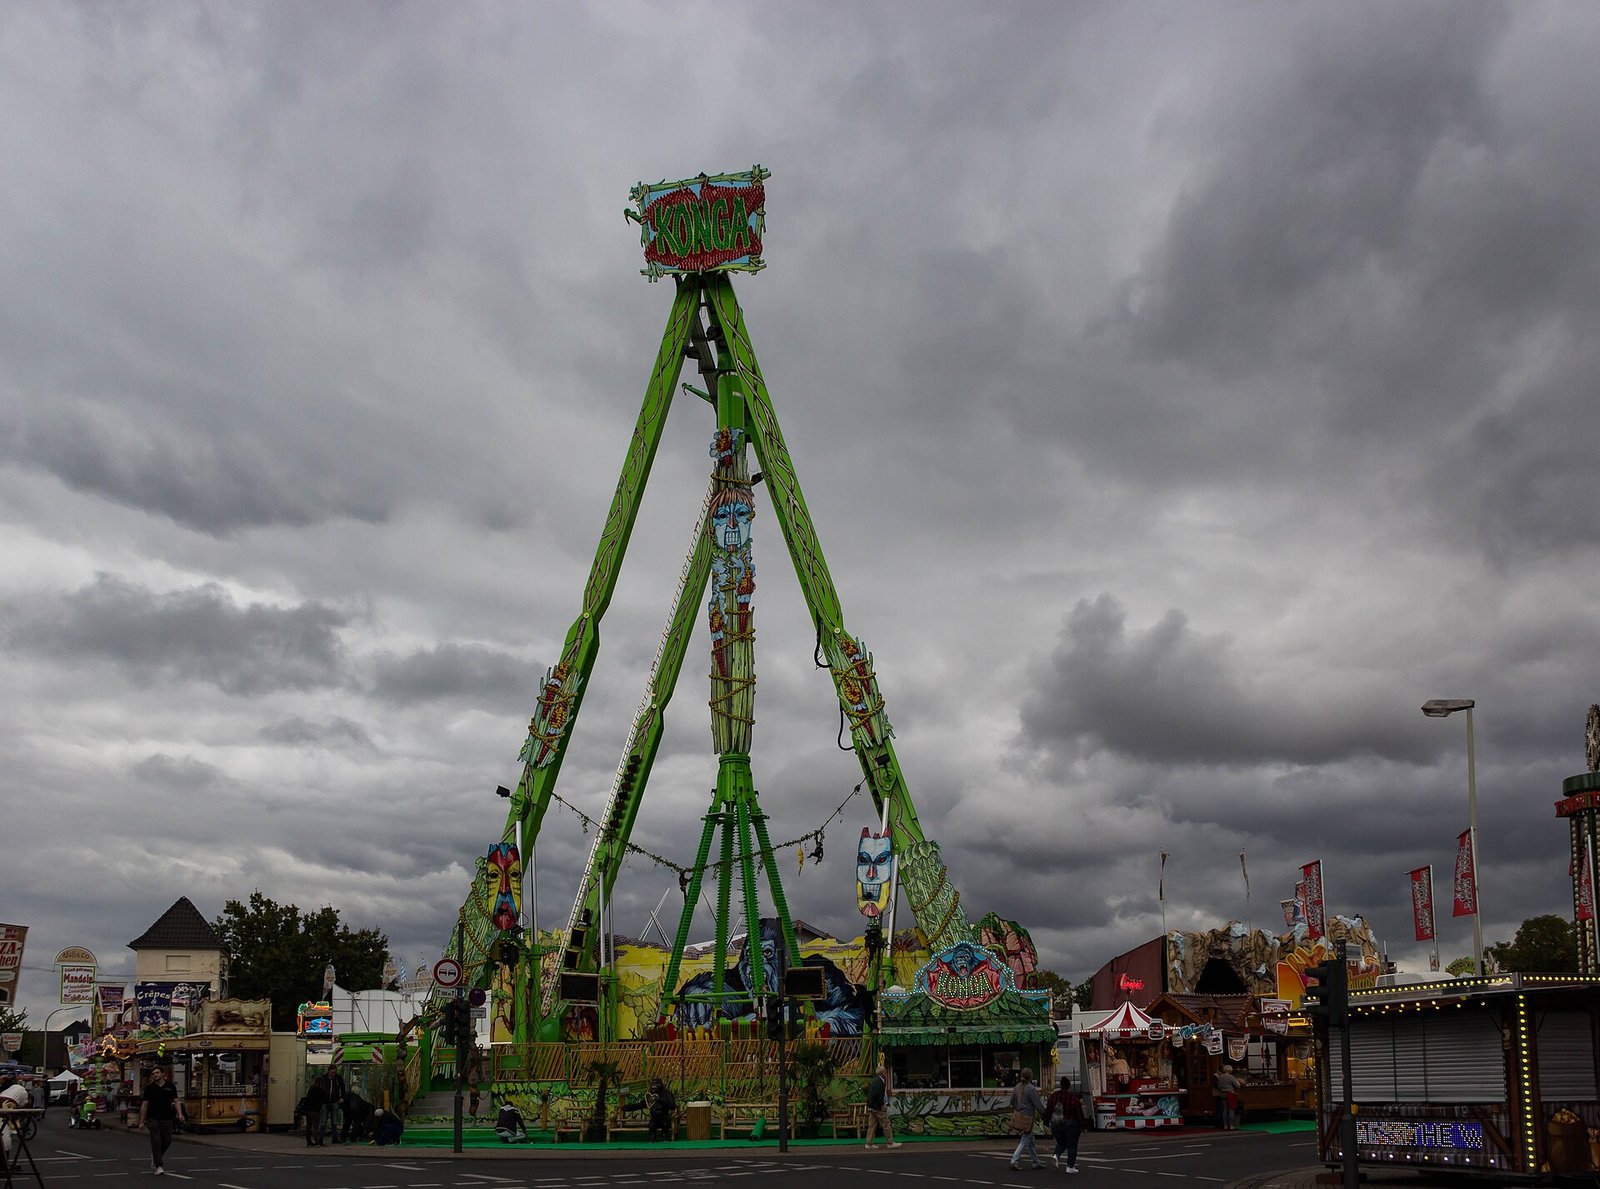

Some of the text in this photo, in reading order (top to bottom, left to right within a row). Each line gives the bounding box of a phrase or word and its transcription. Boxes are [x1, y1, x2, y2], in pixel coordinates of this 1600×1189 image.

[654, 196, 750, 258] KONGA
[64, 973, 93, 984] Mandeln
[936, 970, 994, 999] KONGA
[1347, 974, 1375, 990] hurros
[137, 989, 171, 1001] Crêpes
